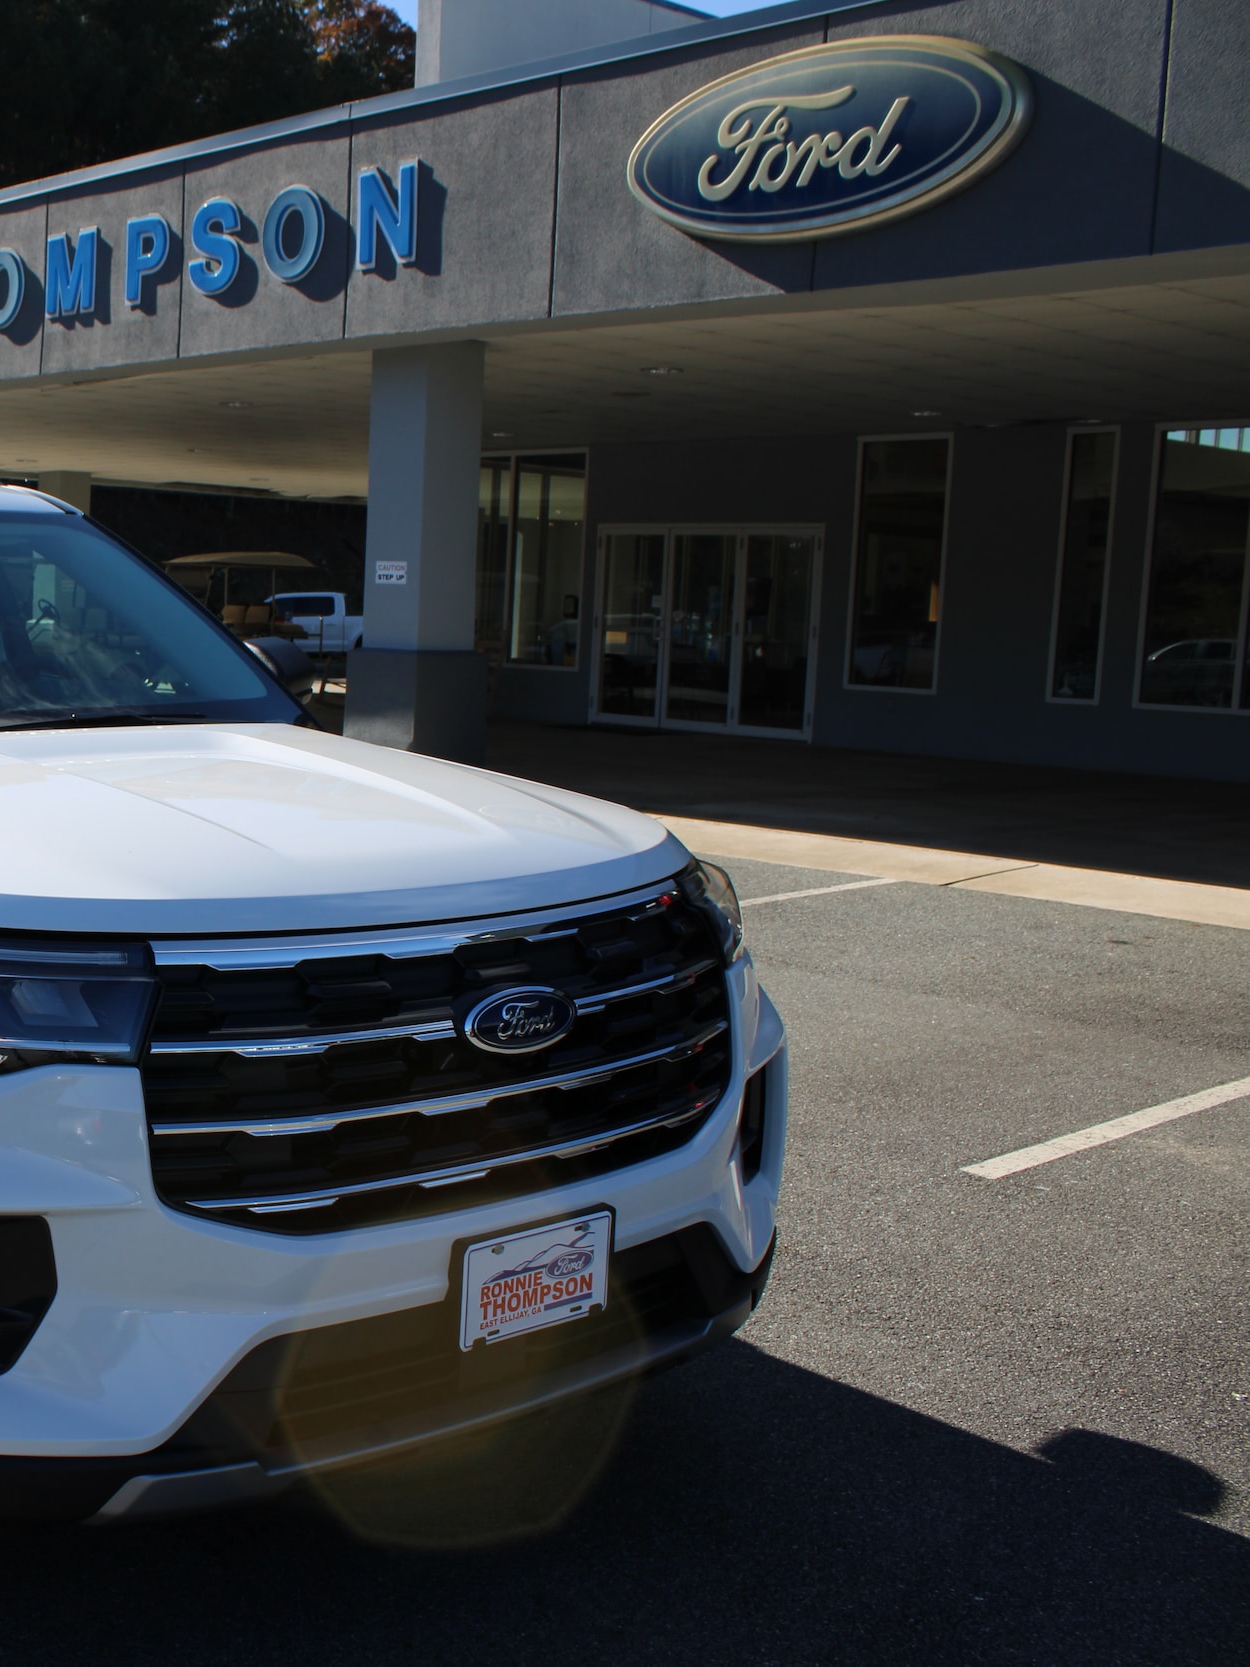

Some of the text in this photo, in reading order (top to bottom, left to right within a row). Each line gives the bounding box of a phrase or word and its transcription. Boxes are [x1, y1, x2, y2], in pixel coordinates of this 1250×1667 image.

[698, 84, 910, 201] Ford
[497, 1000, 556, 1040] Ford
[554, 1254, 586, 1275] Ford
[480, 1271, 543, 1302] RONNIE
[480, 1272, 593, 1320] THOMPSON
[480, 1306, 542, 1330] EAST ELLIJAY, GA
